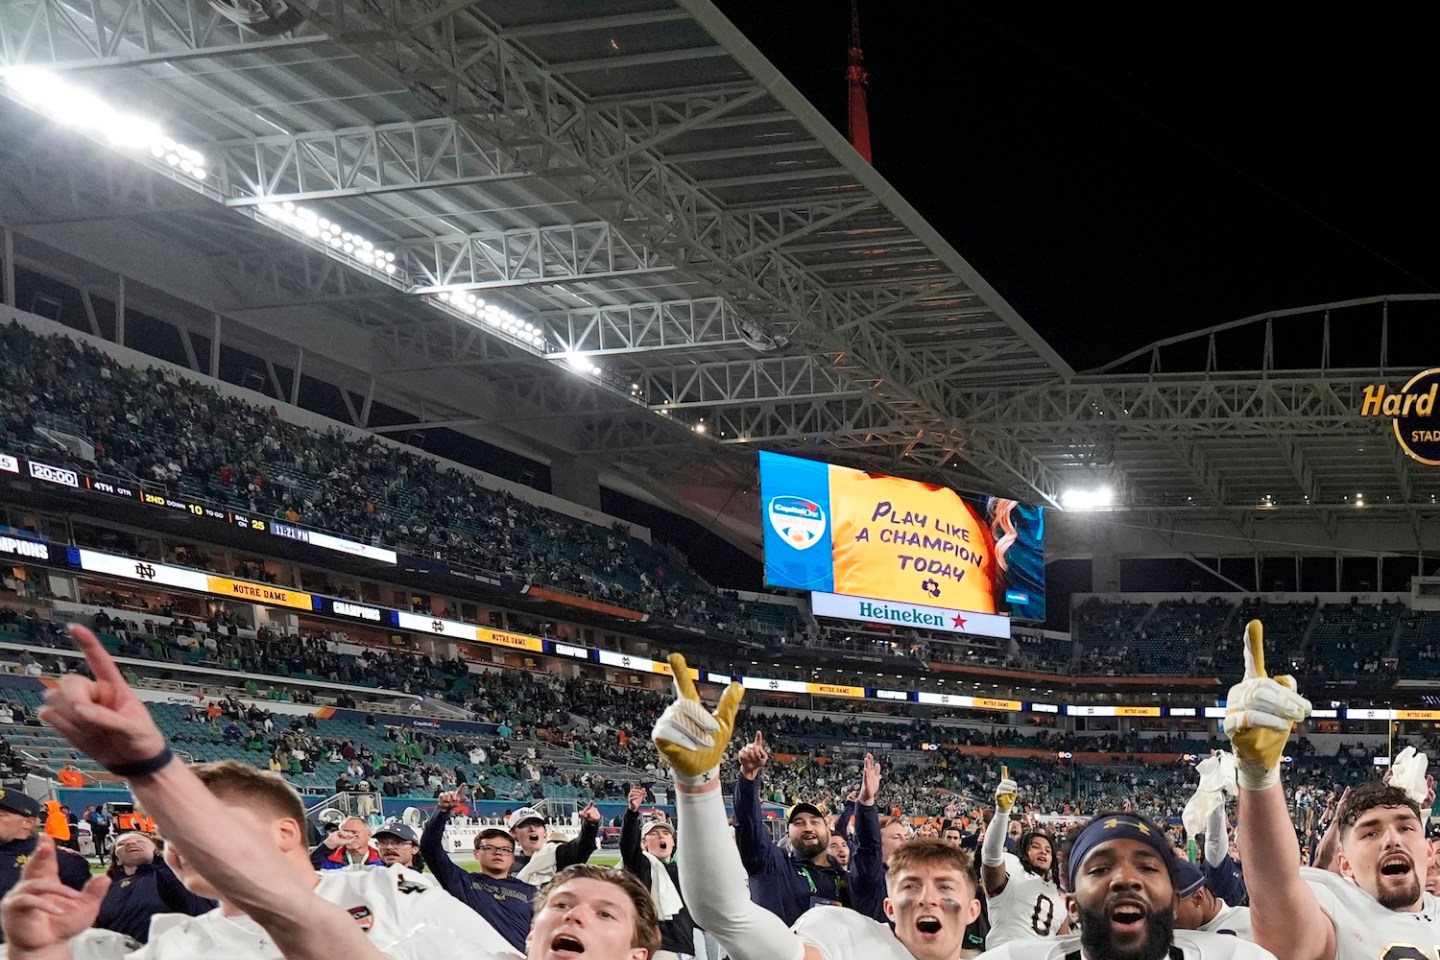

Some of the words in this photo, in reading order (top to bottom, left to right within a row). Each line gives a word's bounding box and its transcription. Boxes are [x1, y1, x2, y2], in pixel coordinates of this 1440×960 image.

[1360, 382, 1439, 417] Hard
[33, 465, 75, 484] 20:00
[94, 482, 114, 494] 4TH
[117, 487, 132, 497] QTR
[145, 493, 165, 506] 2ND
[166, 499, 186, 510] DOWN
[188, 503, 203, 516] 10
[235, 513, 249, 523] BALL
[251, 519, 265, 531] 25
[275, 524, 295, 539] 11:21
[872, 501, 927, 528] PLAY
[935, 519, 970, 542] LIKE
[856, 527, 870, 542] A
[880, 528, 983, 567] CHAMPION
[897, 554, 966, 582] TODAY
[232, 583, 261, 597] NOTRE
[263, 590, 287, 602] DAME
[332, 601, 381, 621] CHAMPIONS
[859, 602, 945, 627] Heineken
[491, 633, 510, 643] NOTRE
[511, 636, 526, 646] DAME
